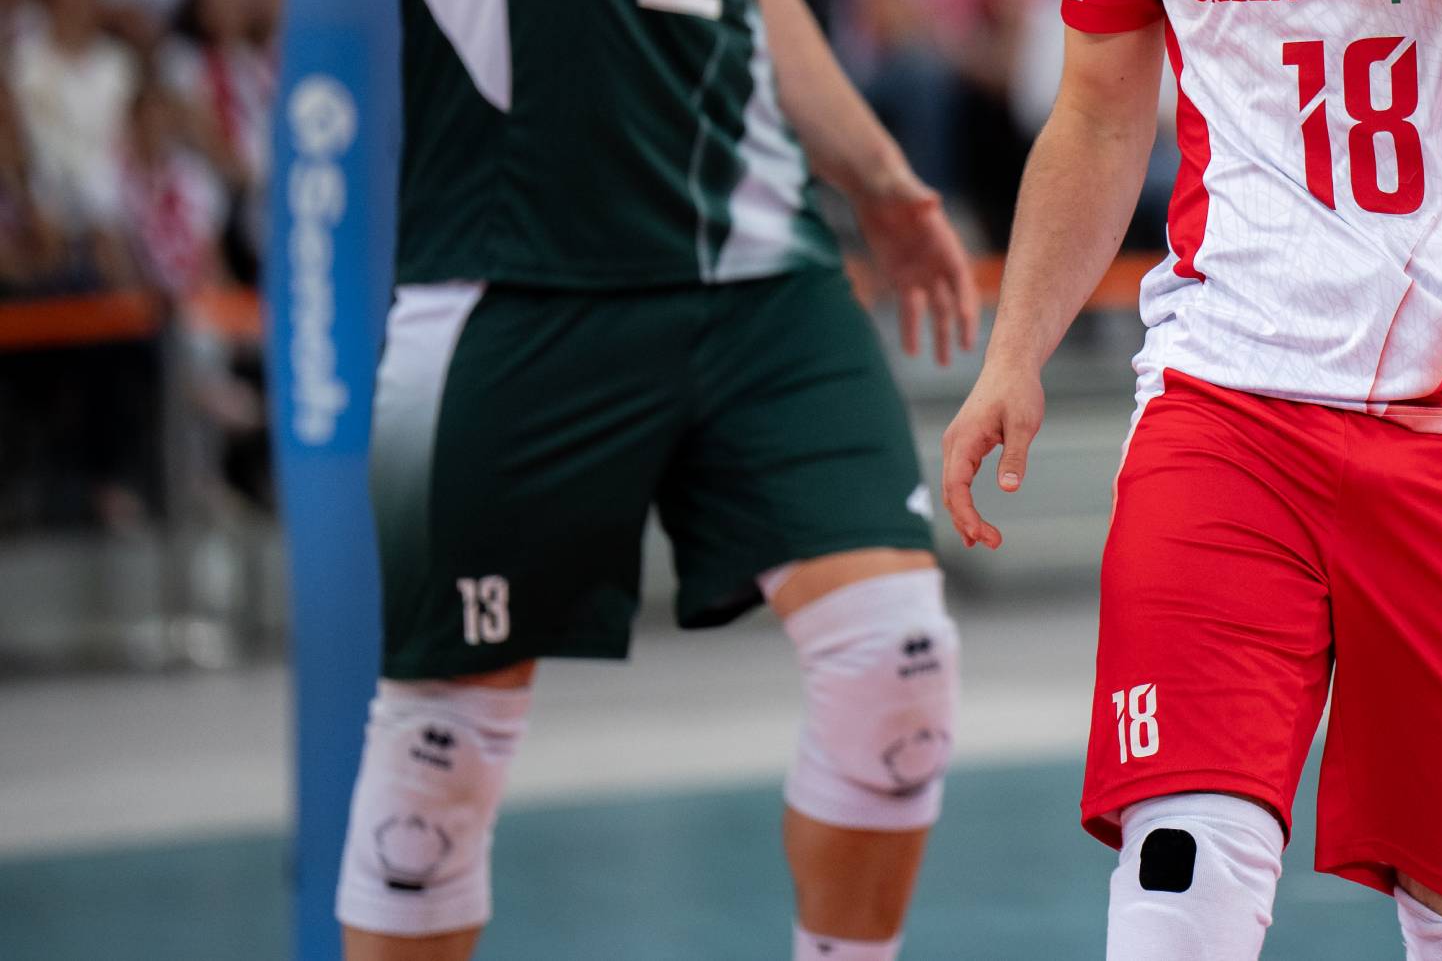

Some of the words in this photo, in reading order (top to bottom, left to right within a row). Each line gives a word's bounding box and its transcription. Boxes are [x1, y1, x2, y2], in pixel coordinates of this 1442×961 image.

[1282, 36, 1426, 215] 18
[456, 575, 511, 644] 13
[1112, 683, 1159, 764] 18
